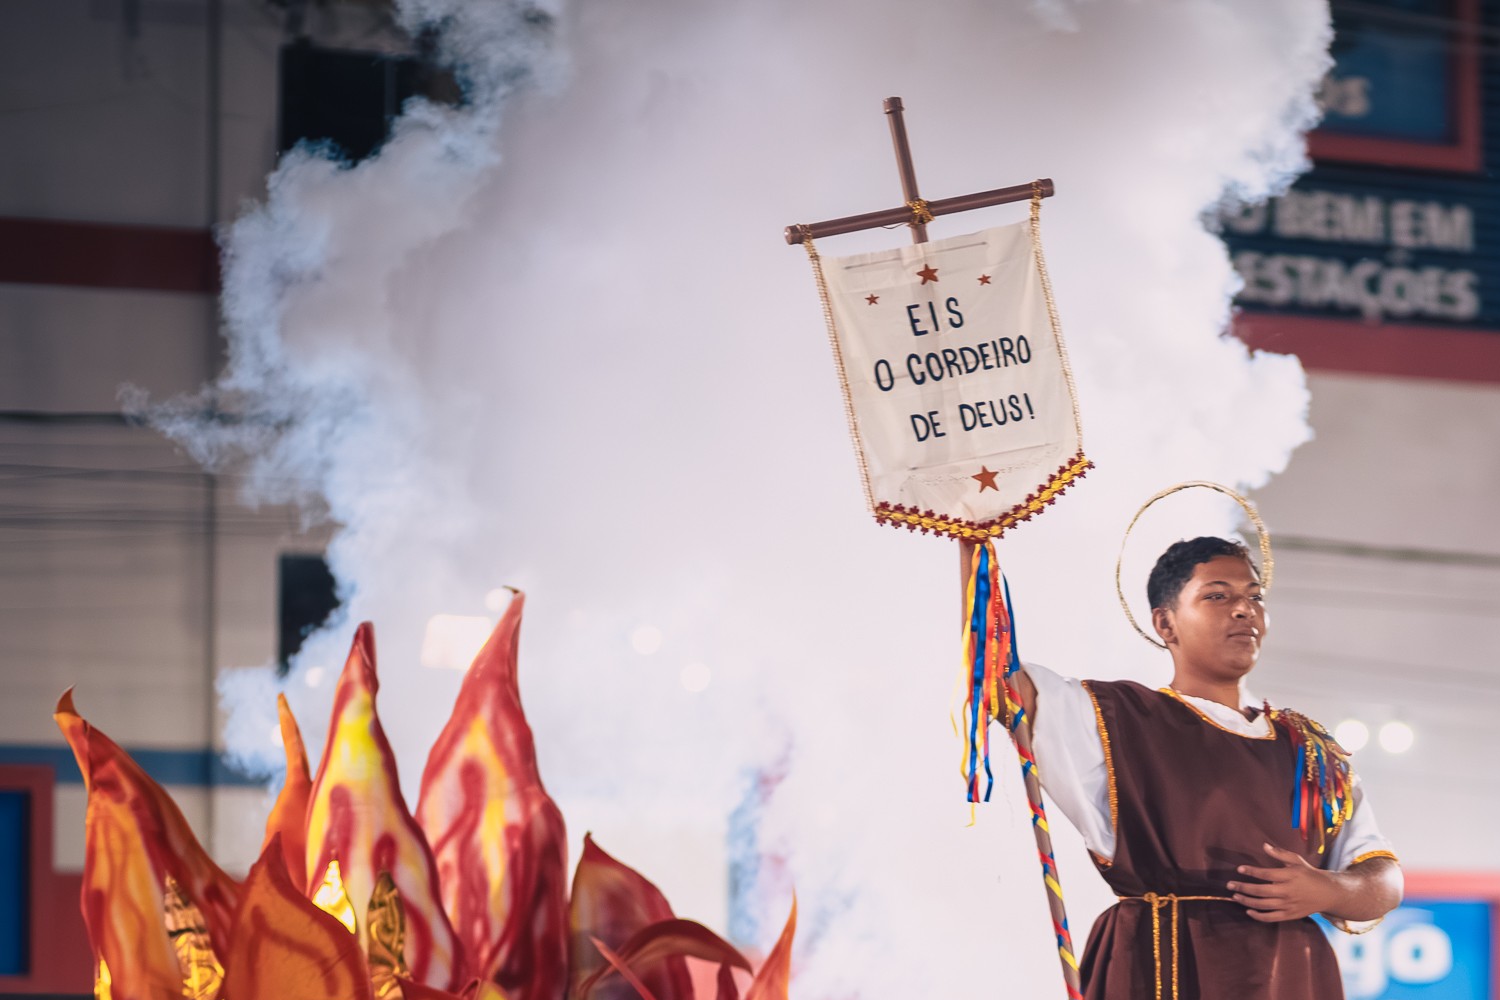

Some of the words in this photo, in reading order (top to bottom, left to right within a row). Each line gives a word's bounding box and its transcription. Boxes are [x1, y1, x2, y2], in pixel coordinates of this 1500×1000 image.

[1273, 188, 1387, 244] BEM
[1390, 198, 1475, 252] EM
[906, 296, 965, 336] EIS
[873, 359, 895, 392] O
[906, 334, 1032, 386] CORDEIRO
[910, 410, 946, 443] DE
[957, 392, 1036, 433] DEUS!
